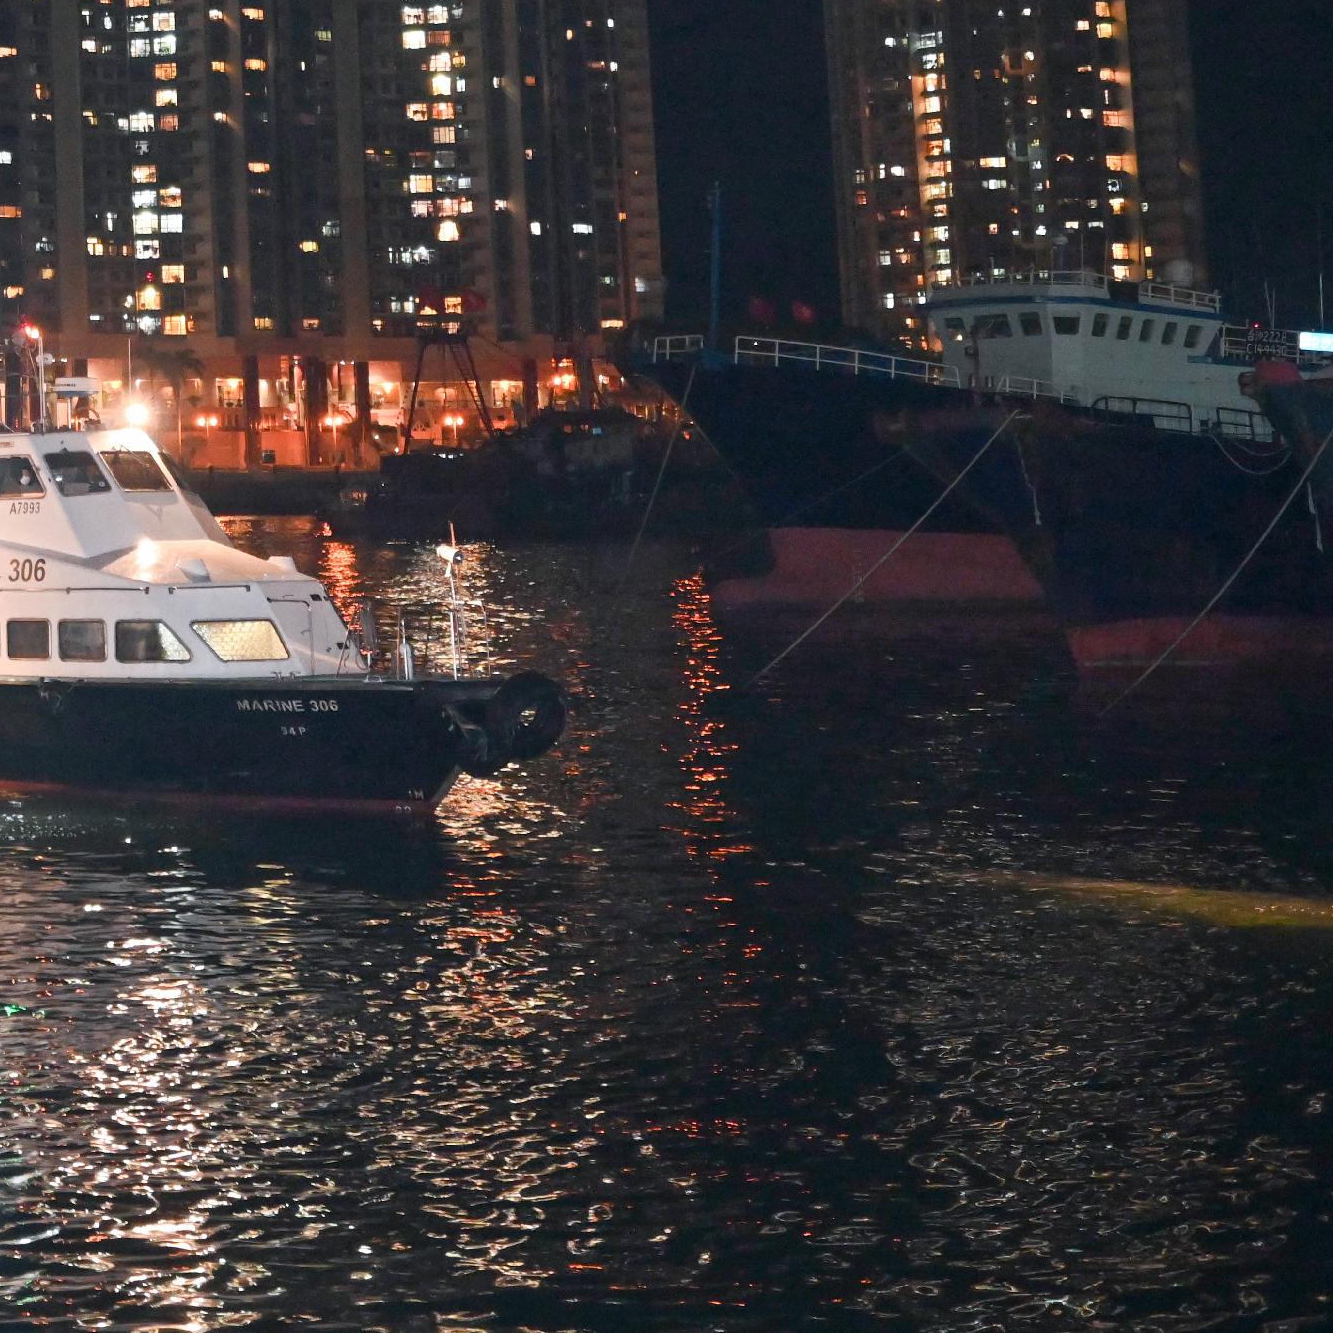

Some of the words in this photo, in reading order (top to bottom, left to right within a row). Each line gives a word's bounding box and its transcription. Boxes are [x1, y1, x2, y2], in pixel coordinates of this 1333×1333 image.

[9, 501, 41, 515] A7993
[8, 558, 46, 582] 306
[236, 699, 305, 713] MARINE
[309, 699, 339, 713] 306
